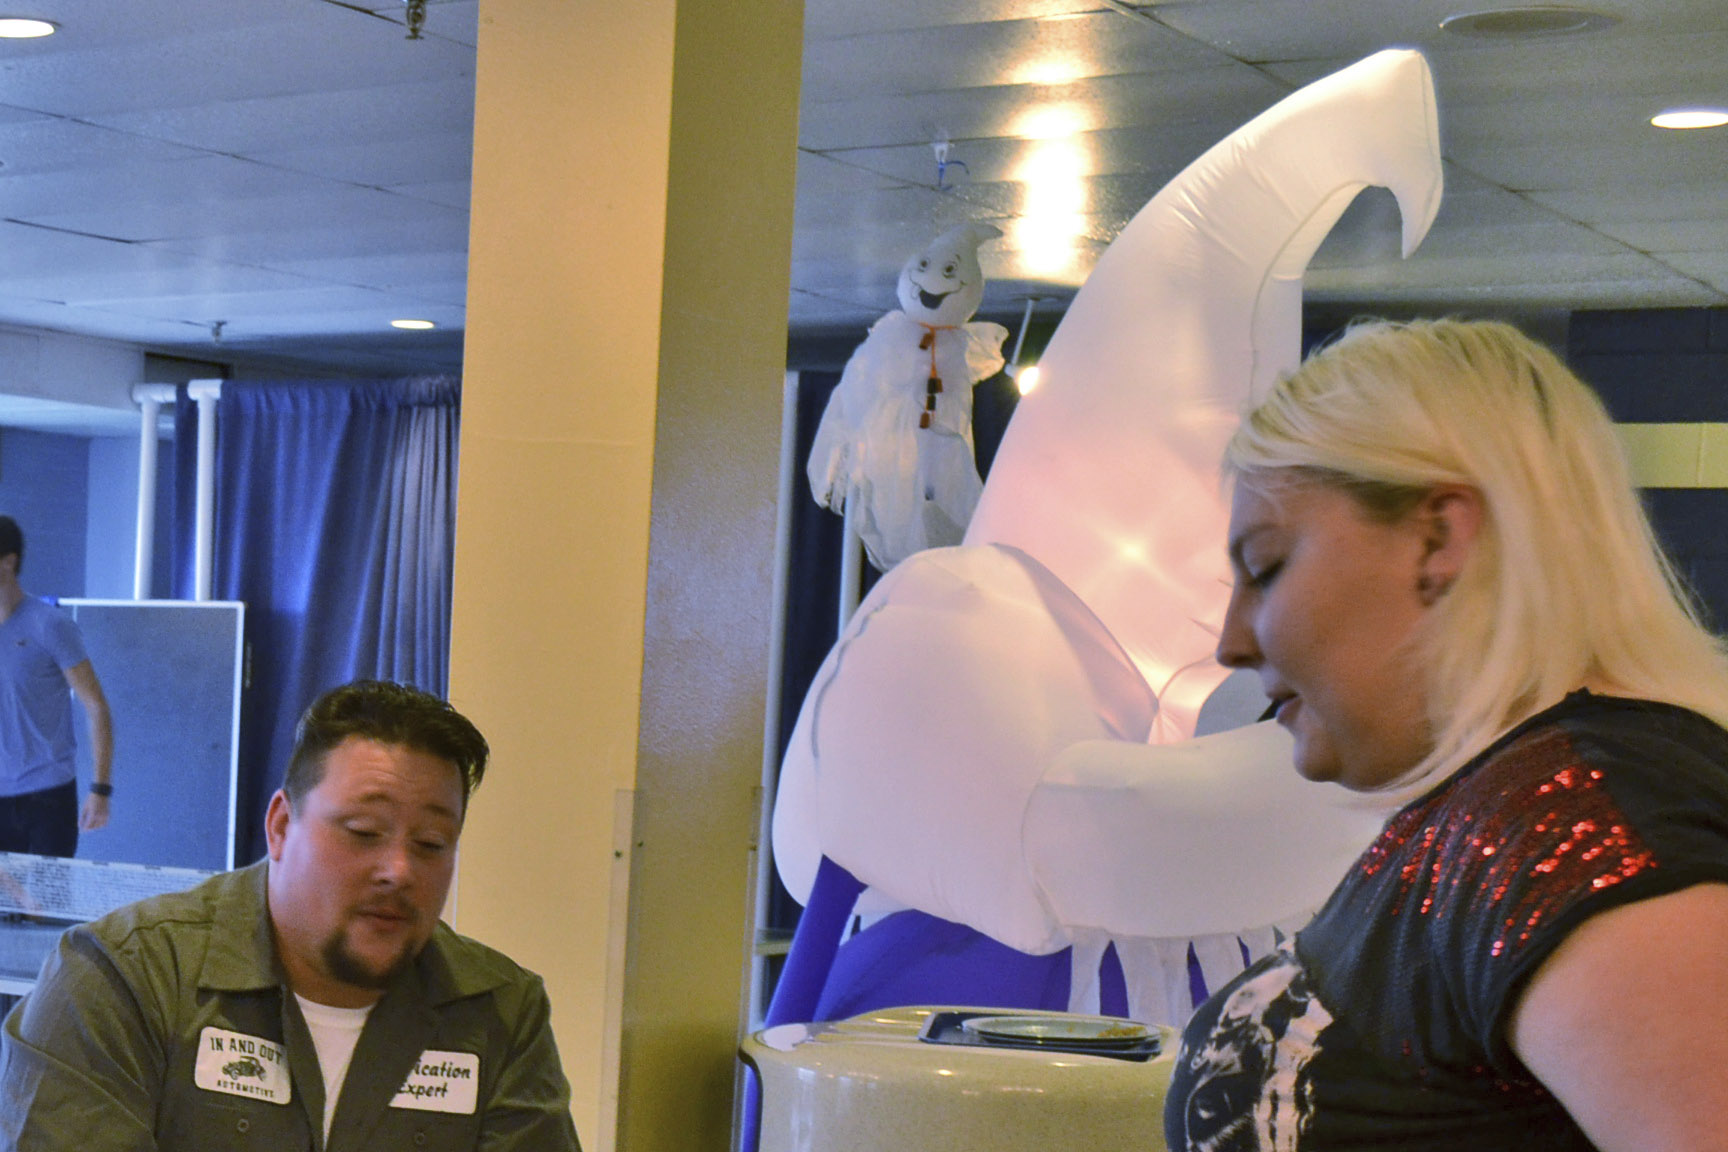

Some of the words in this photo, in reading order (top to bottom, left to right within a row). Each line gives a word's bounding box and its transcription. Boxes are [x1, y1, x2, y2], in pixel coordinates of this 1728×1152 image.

[210, 1037, 223, 1051] IN
[229, 1038, 255, 1054] AND
[259, 1044, 282, 1065] OUT
[217, 1080, 274, 1098] AUTOMOTIVE
